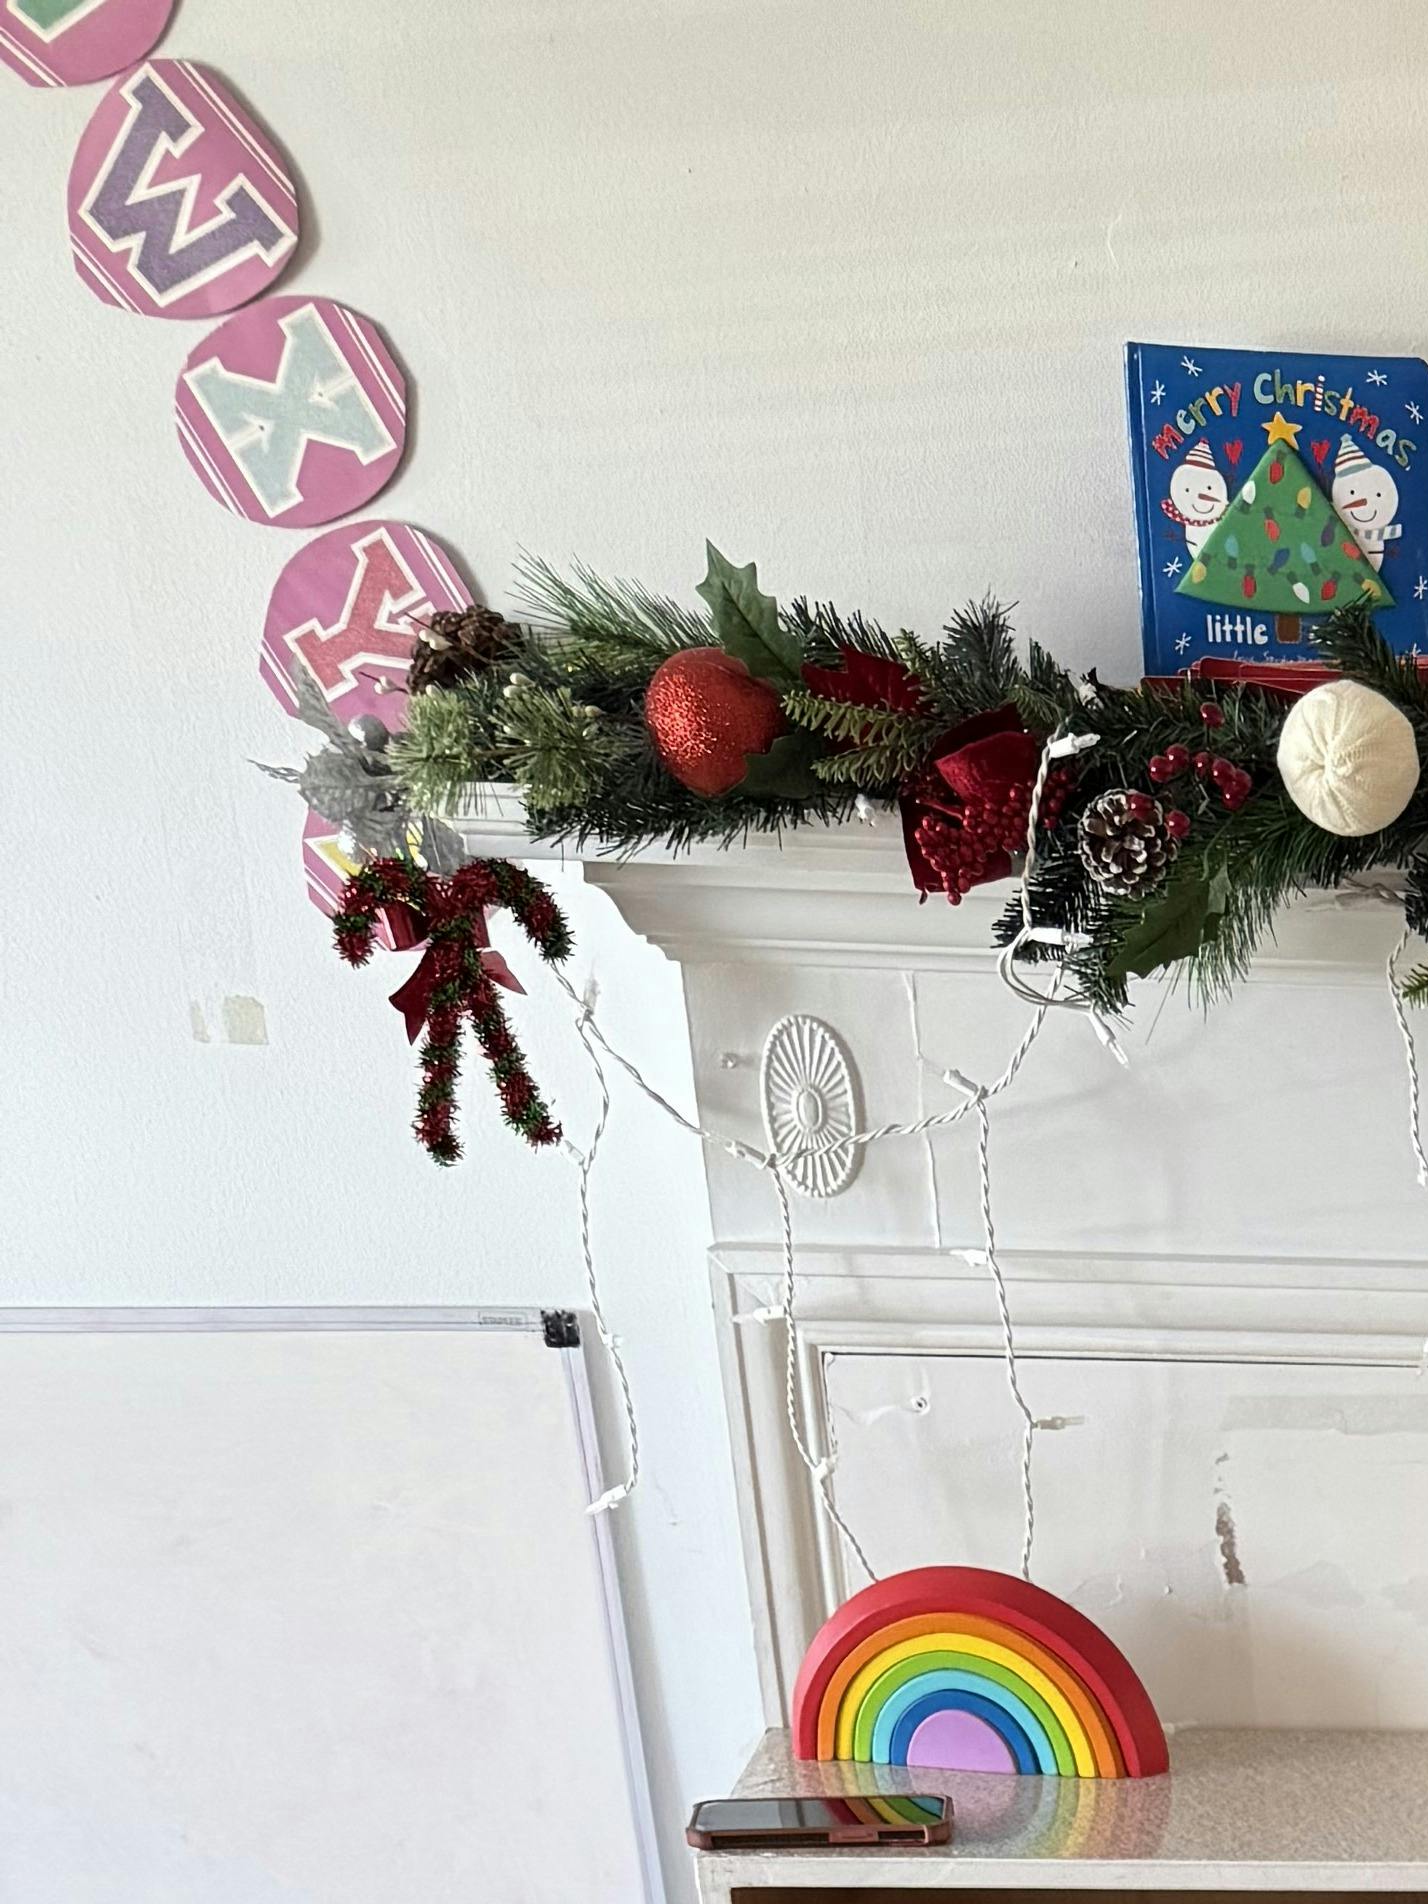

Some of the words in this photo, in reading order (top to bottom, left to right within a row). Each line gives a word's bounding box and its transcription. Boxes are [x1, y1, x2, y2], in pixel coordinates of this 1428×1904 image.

[78, 59, 298, 307] W
[182, 302, 397, 518] X
[1253, 368, 1418, 472] Christmas
[284, 526, 435, 702] Y
[1206, 614, 1269, 646] little
